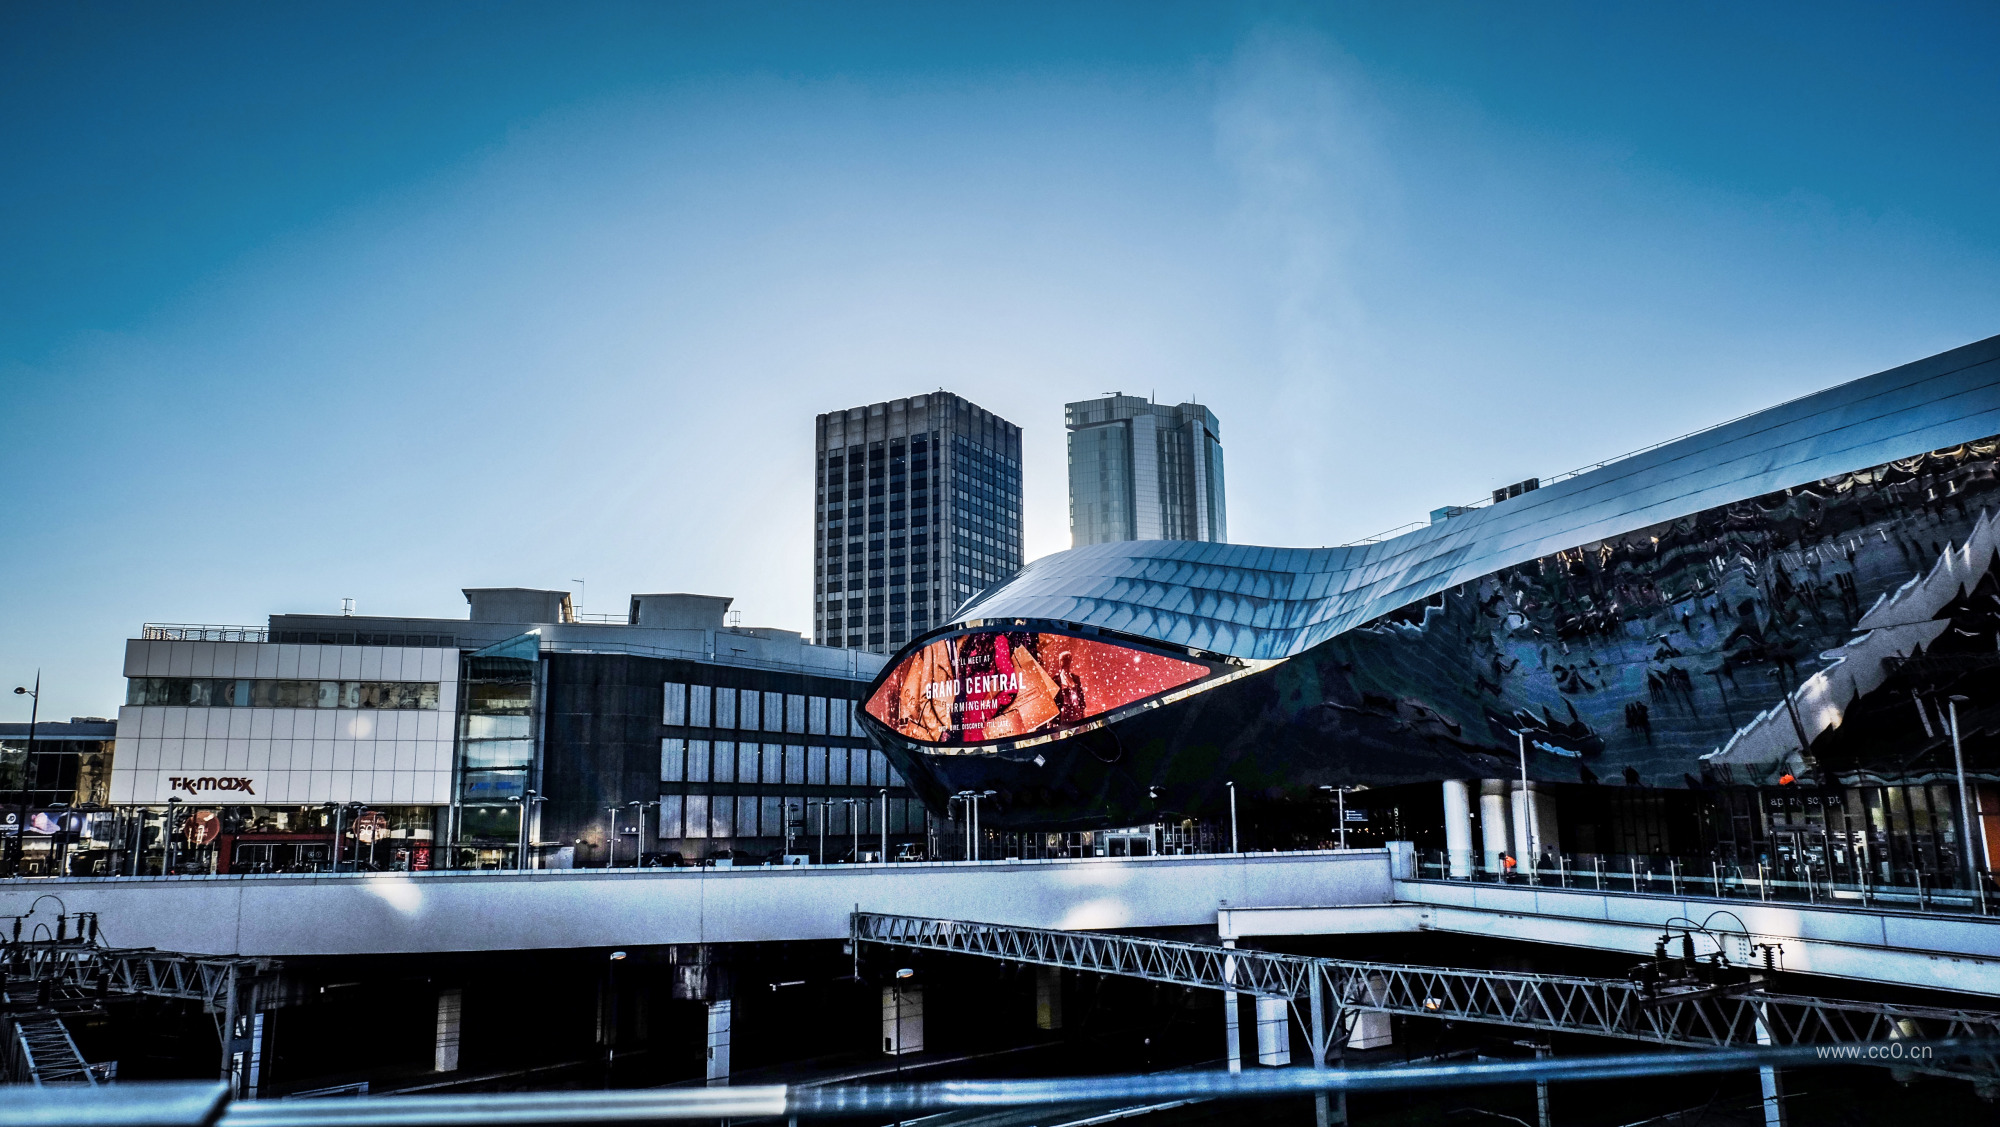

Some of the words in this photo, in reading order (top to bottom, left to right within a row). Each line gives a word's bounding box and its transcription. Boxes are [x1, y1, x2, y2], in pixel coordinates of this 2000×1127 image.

[967, 655, 982, 665] MEET
[984, 654, 990, 663] AT
[926, 679, 960, 699] GRAND
[966, 672, 1027, 694] CENTRAL
[946, 698, 998, 713] BIRMINGHAM
